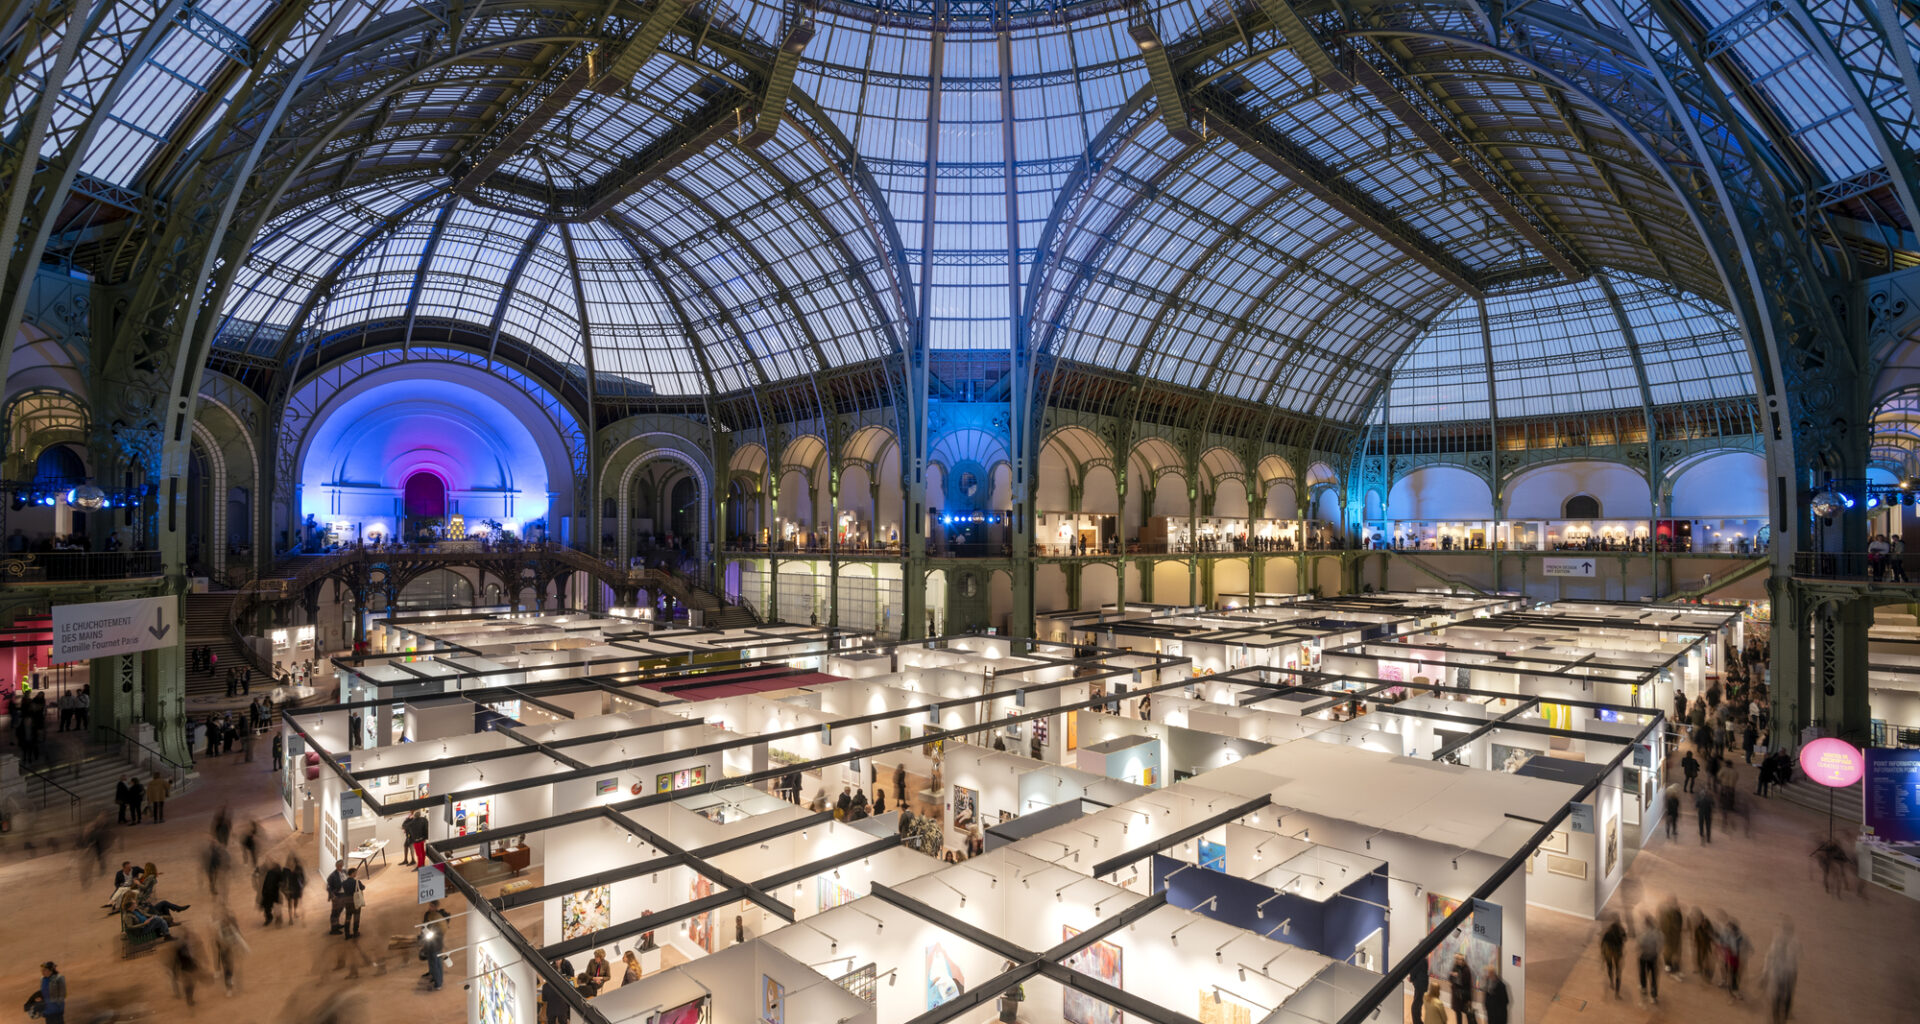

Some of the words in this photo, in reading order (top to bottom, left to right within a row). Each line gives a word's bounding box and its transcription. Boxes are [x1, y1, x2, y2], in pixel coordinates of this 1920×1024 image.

[62, 624, 71, 633] LE
[72, 617, 132, 631] CHUCHOTEMENT
[62, 634, 77, 644] DES
[78, 630, 103, 640] MAINS
[62, 642, 91, 654] Camille
[92, 638, 120, 650] Fournet
[122, 636, 138, 646] Paris
[420, 889, 434, 898] C10
